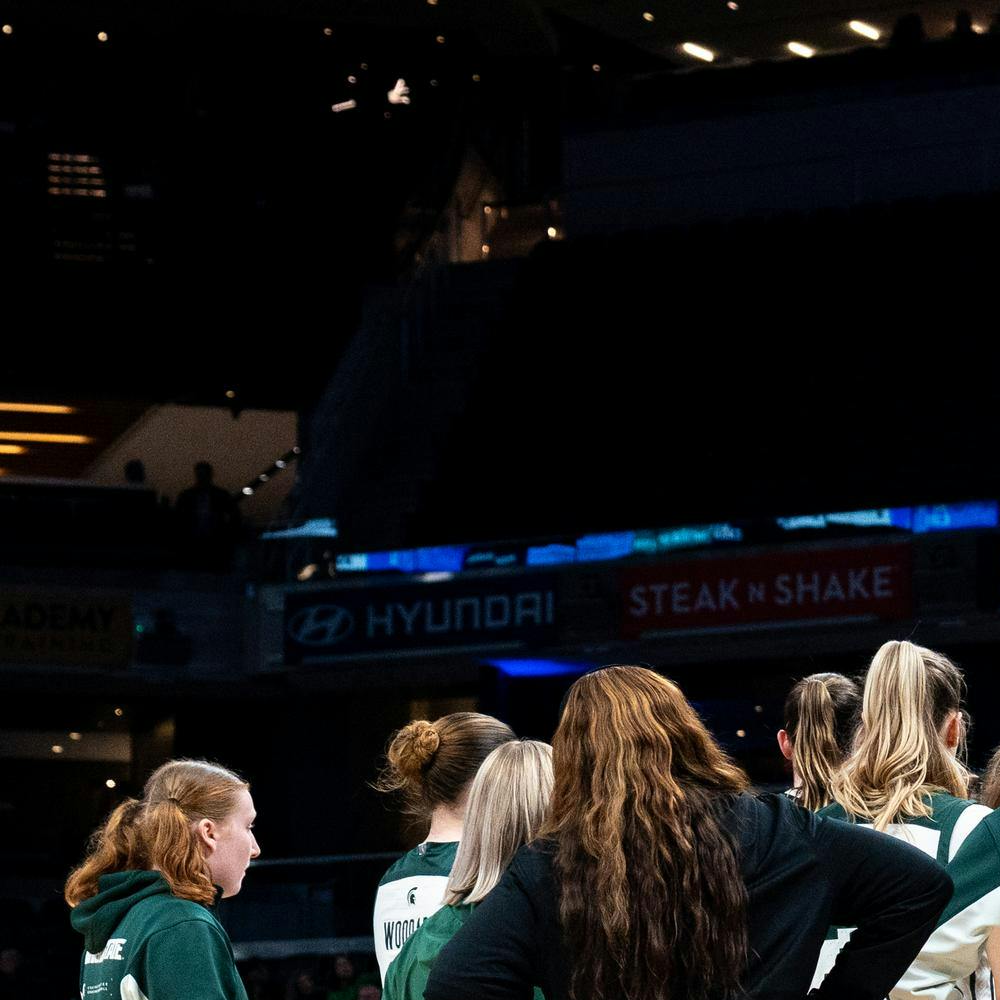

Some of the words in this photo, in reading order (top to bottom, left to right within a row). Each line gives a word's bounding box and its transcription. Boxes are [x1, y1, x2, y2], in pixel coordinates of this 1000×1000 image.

[365, 590, 557, 639] HYUNDAI
[629, 578, 740, 617] STEAK
[774, 565, 894, 606] SHAKE
